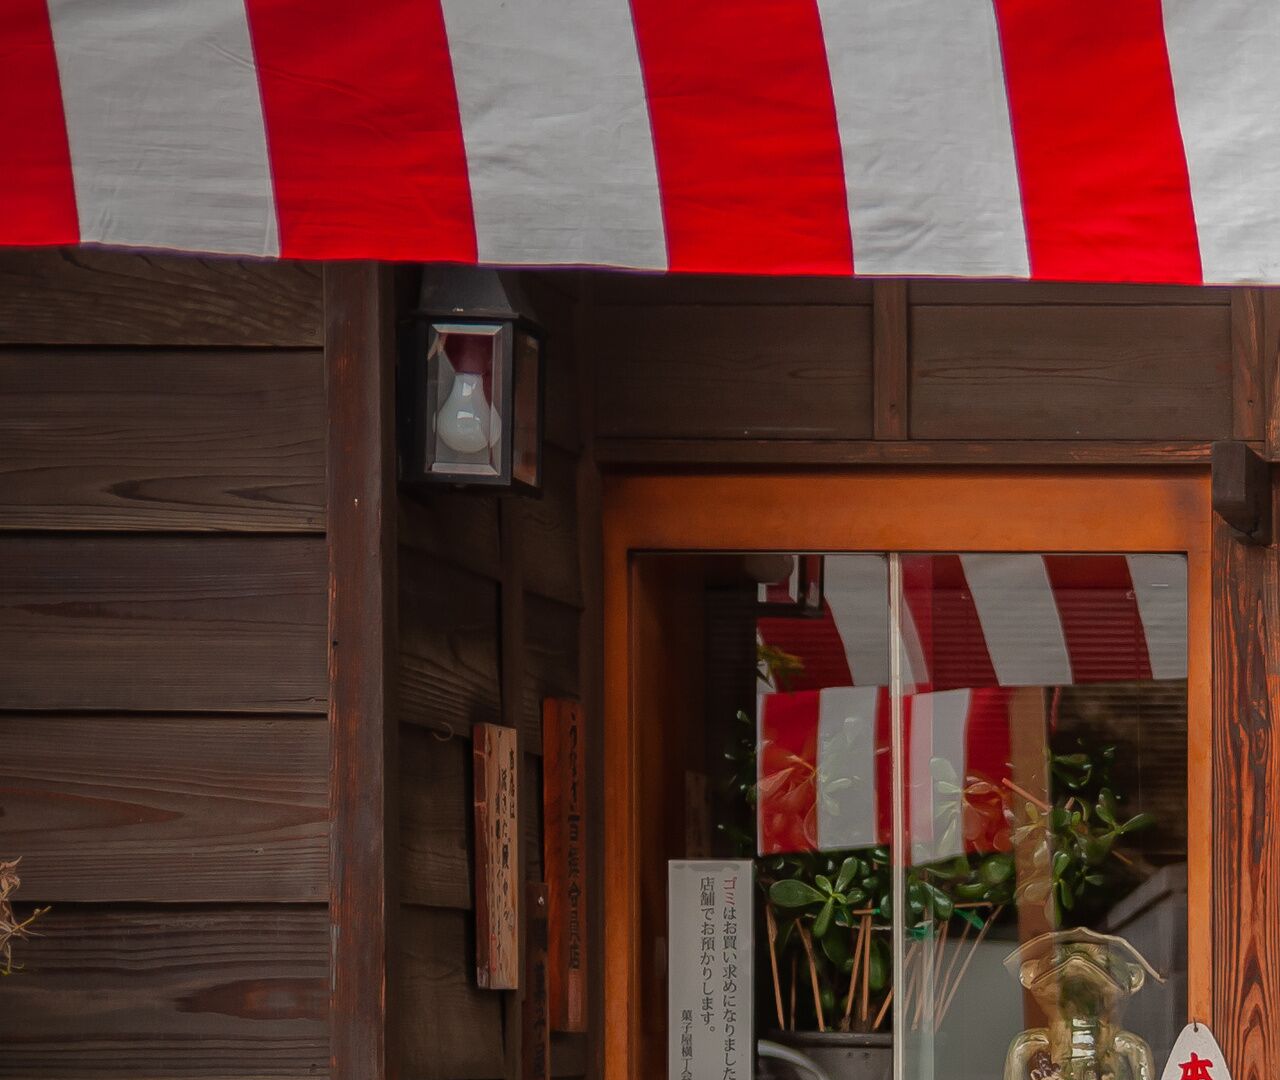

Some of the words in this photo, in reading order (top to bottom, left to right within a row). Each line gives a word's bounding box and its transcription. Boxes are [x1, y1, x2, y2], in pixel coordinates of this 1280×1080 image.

[699, 877, 716, 1033] 店舗でお預かりします。
